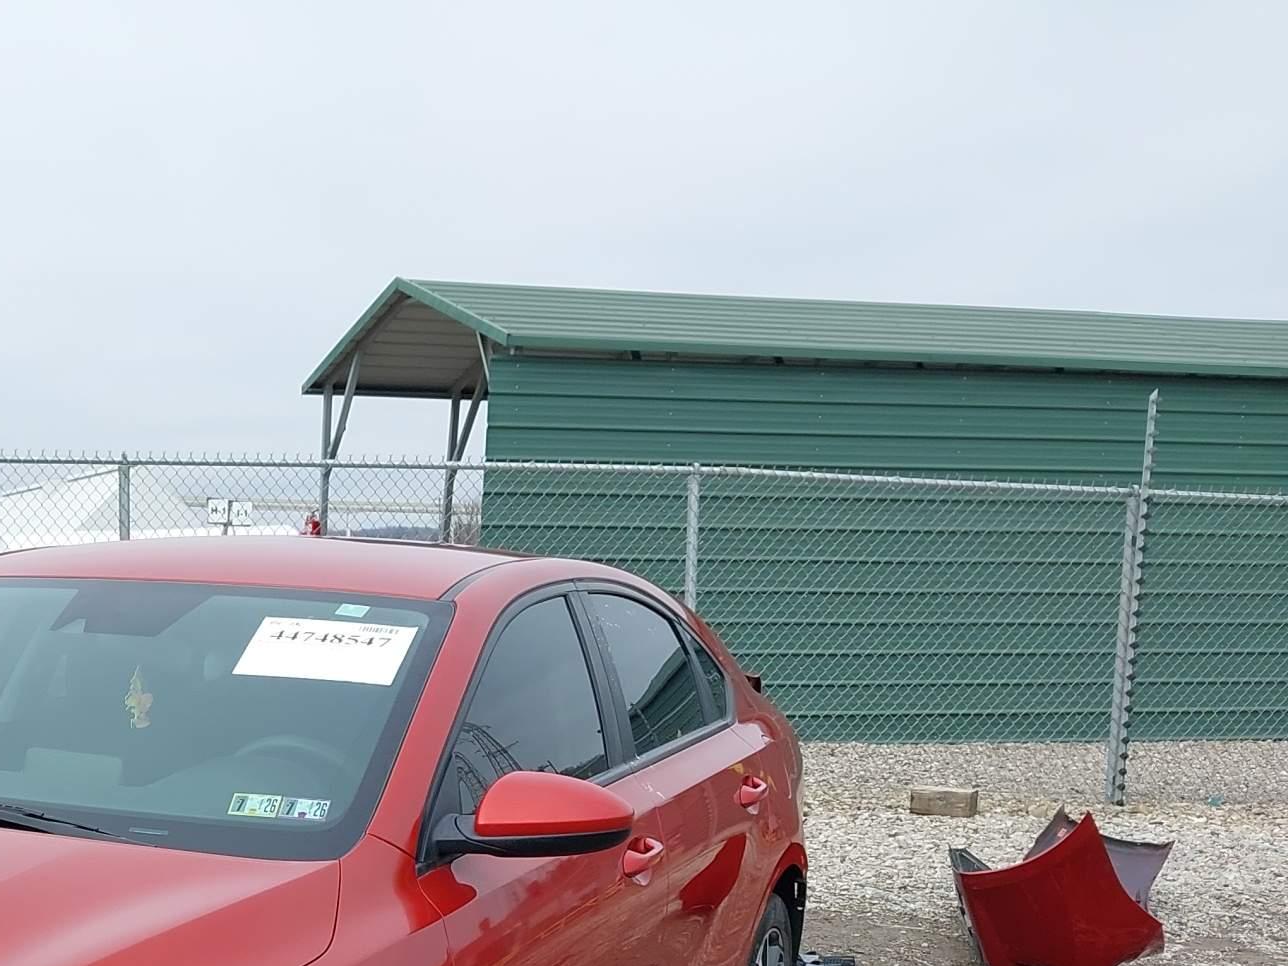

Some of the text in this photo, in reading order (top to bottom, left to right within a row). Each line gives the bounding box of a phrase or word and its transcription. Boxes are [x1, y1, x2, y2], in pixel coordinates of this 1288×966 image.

[270, 630, 392, 648] 44748547
[236, 798, 279, 813] 7 26
[285, 801, 328, 817] 7 26
